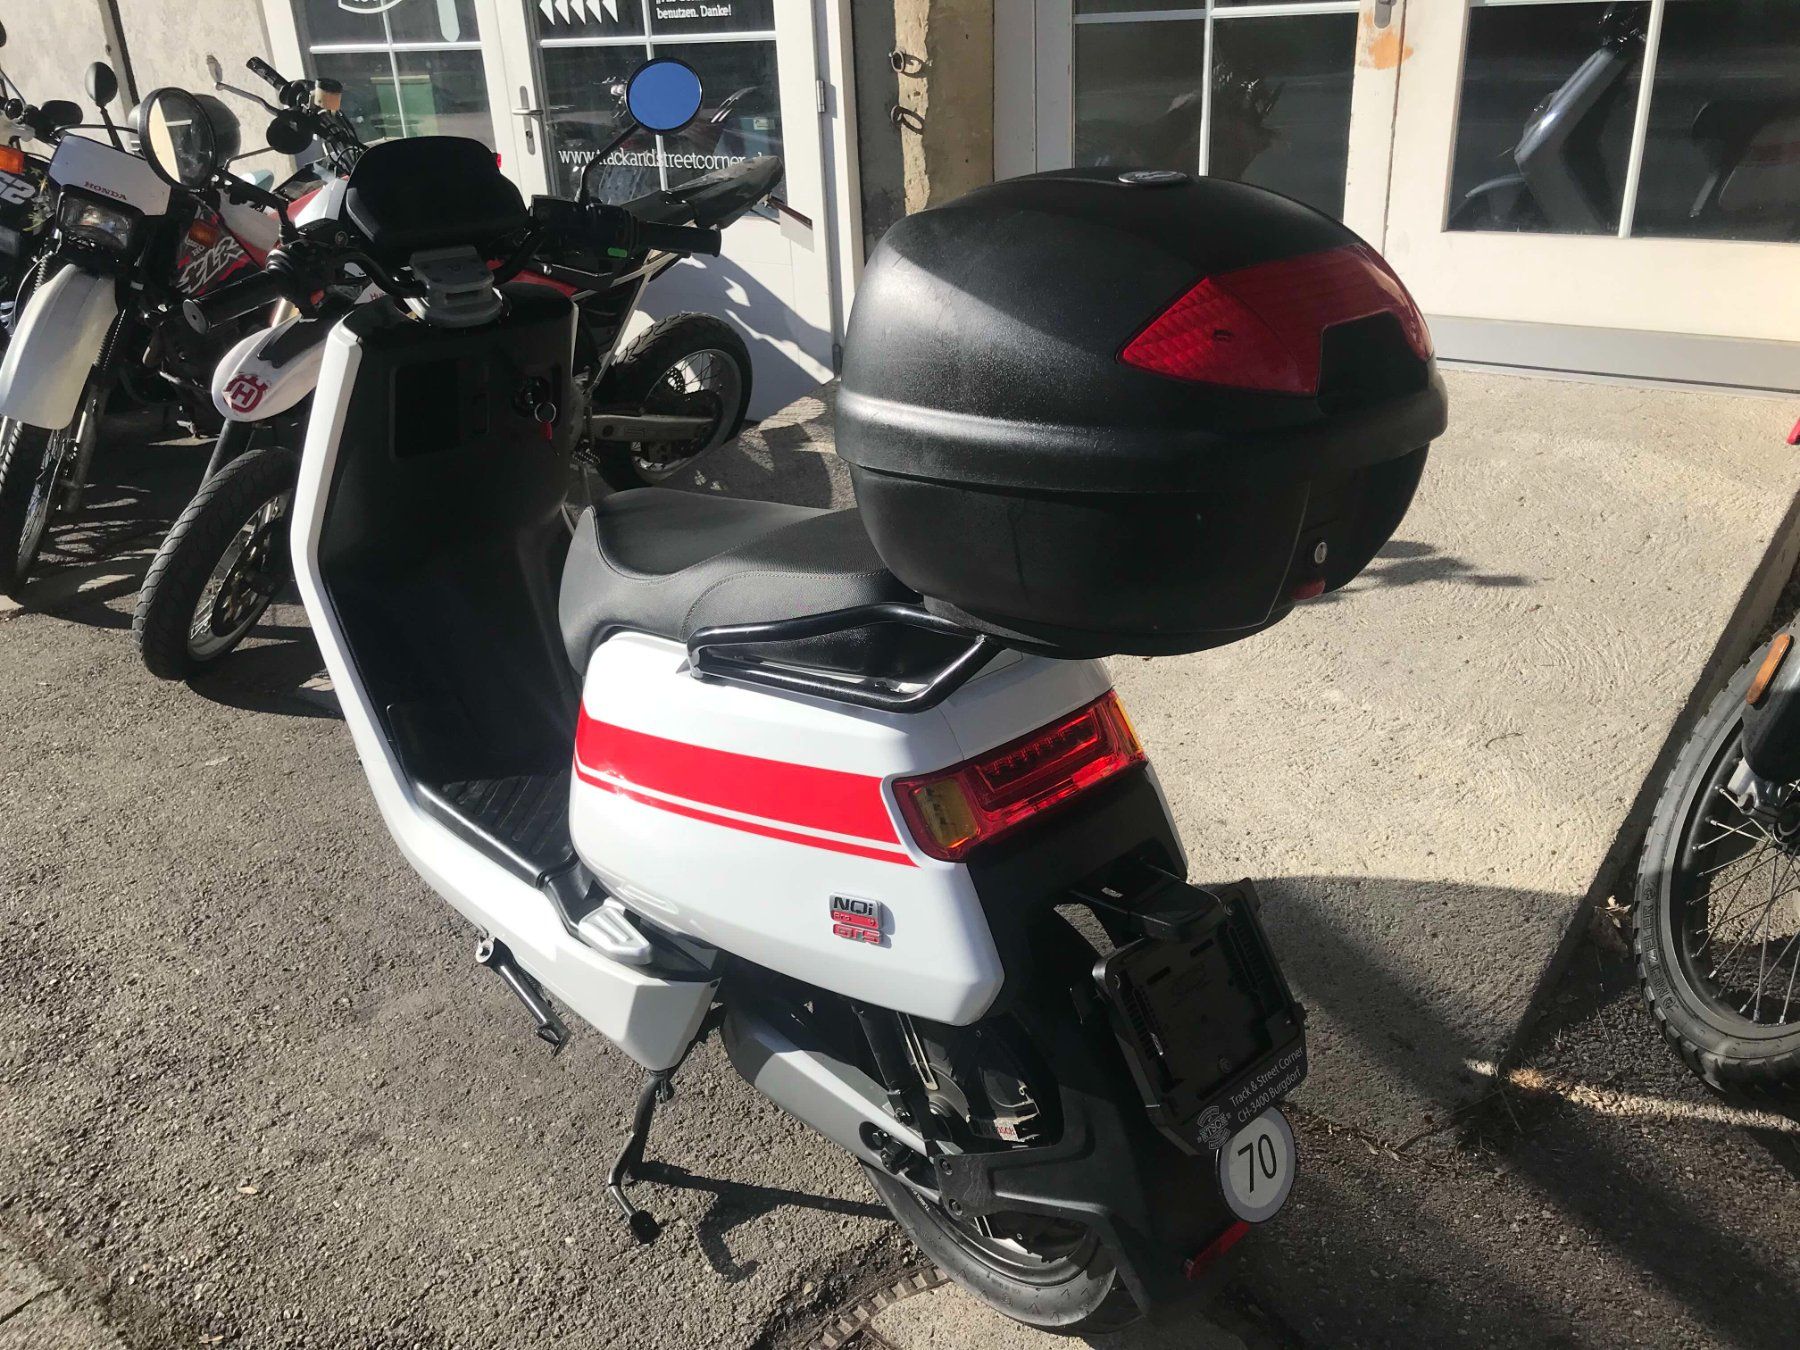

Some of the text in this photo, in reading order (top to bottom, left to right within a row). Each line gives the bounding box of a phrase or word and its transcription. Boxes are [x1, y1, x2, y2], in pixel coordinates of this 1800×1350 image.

[656, 4, 731, 19] benutzen. Danke!
[84, 181, 127, 200] HONDA
[834, 896, 873, 916] NQi
[1229, 1046, 1303, 1107] Track & Street Corner
[1237, 1092, 1270, 1122] CH-3400
[1268, 1065, 1301, 1099] Burgdorf
[1237, 1133, 1277, 1194] 70
